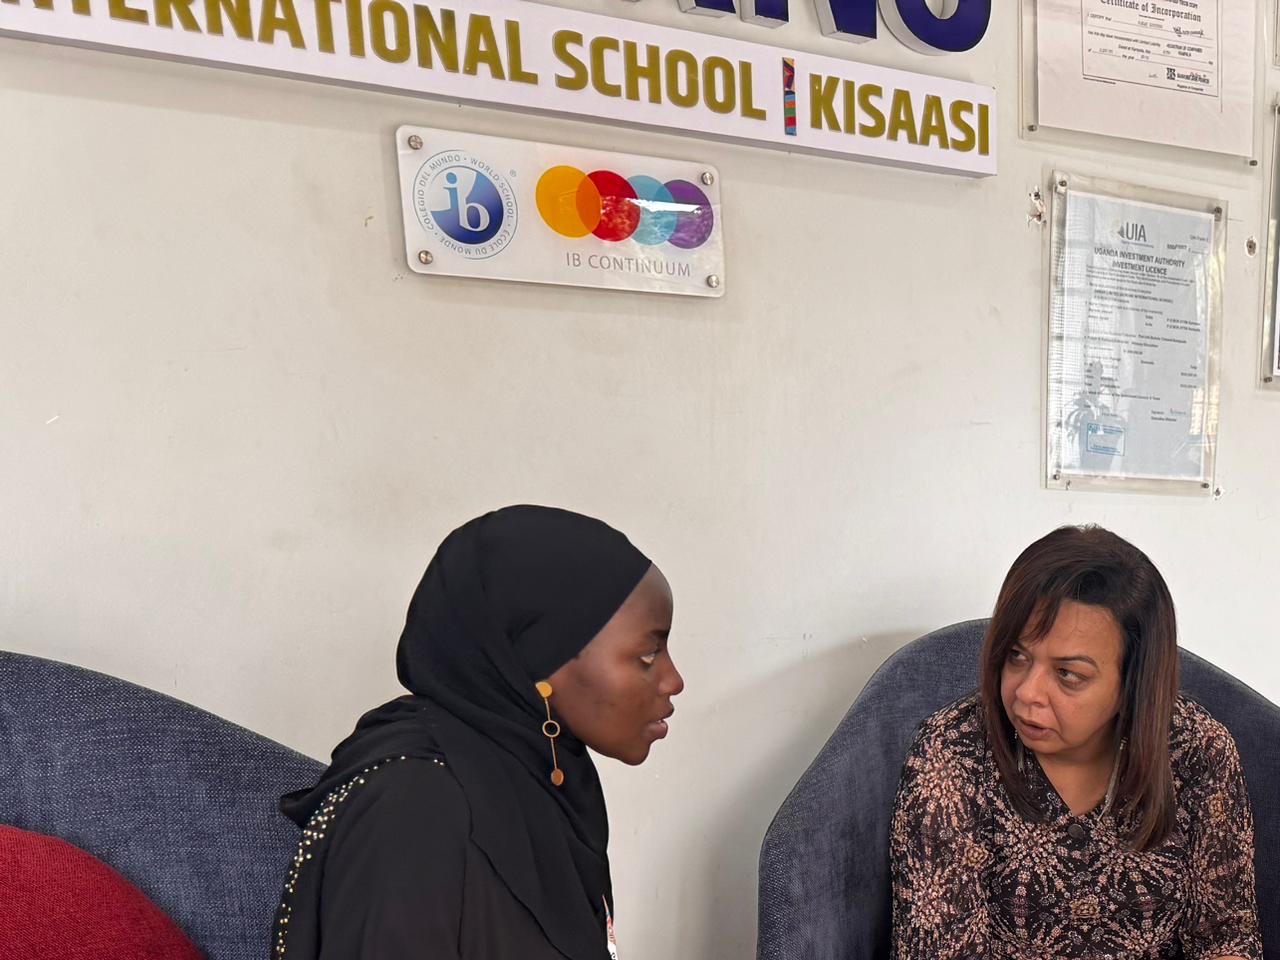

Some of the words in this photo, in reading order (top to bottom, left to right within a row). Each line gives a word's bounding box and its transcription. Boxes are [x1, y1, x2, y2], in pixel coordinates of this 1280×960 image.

[1141, 2, 1149, 12] of
[1151, 3, 1201, 22] Incorporation
[551, 29, 767, 121] SCHOOL
[809, 72, 990, 156] KISAASI
[429, 154, 461, 171] MUNDO
[470, 157, 500, 182] WORLD
[419, 171, 430, 187] DEL
[417, 189, 434, 231] COLEGIO
[443, 171, 490, 232] ib
[499, 182, 514, 219] SCHOOL
[1126, 222, 1147, 242] UIA
[440, 235, 471, 256] MONDE
[475, 247, 488, 256] DU
[566, 252, 582, 268] IB
[588, 253, 691, 277] CONTINUUM
[1094, 247, 1119, 257] UGANDA
[1120, 250, 1154, 263] INVESTMENT
[1154, 256, 1185, 268] AUTHORITY
[1112, 260, 1145, 272] INVESTMENT
[1145, 265, 1168, 275] LICENCE
